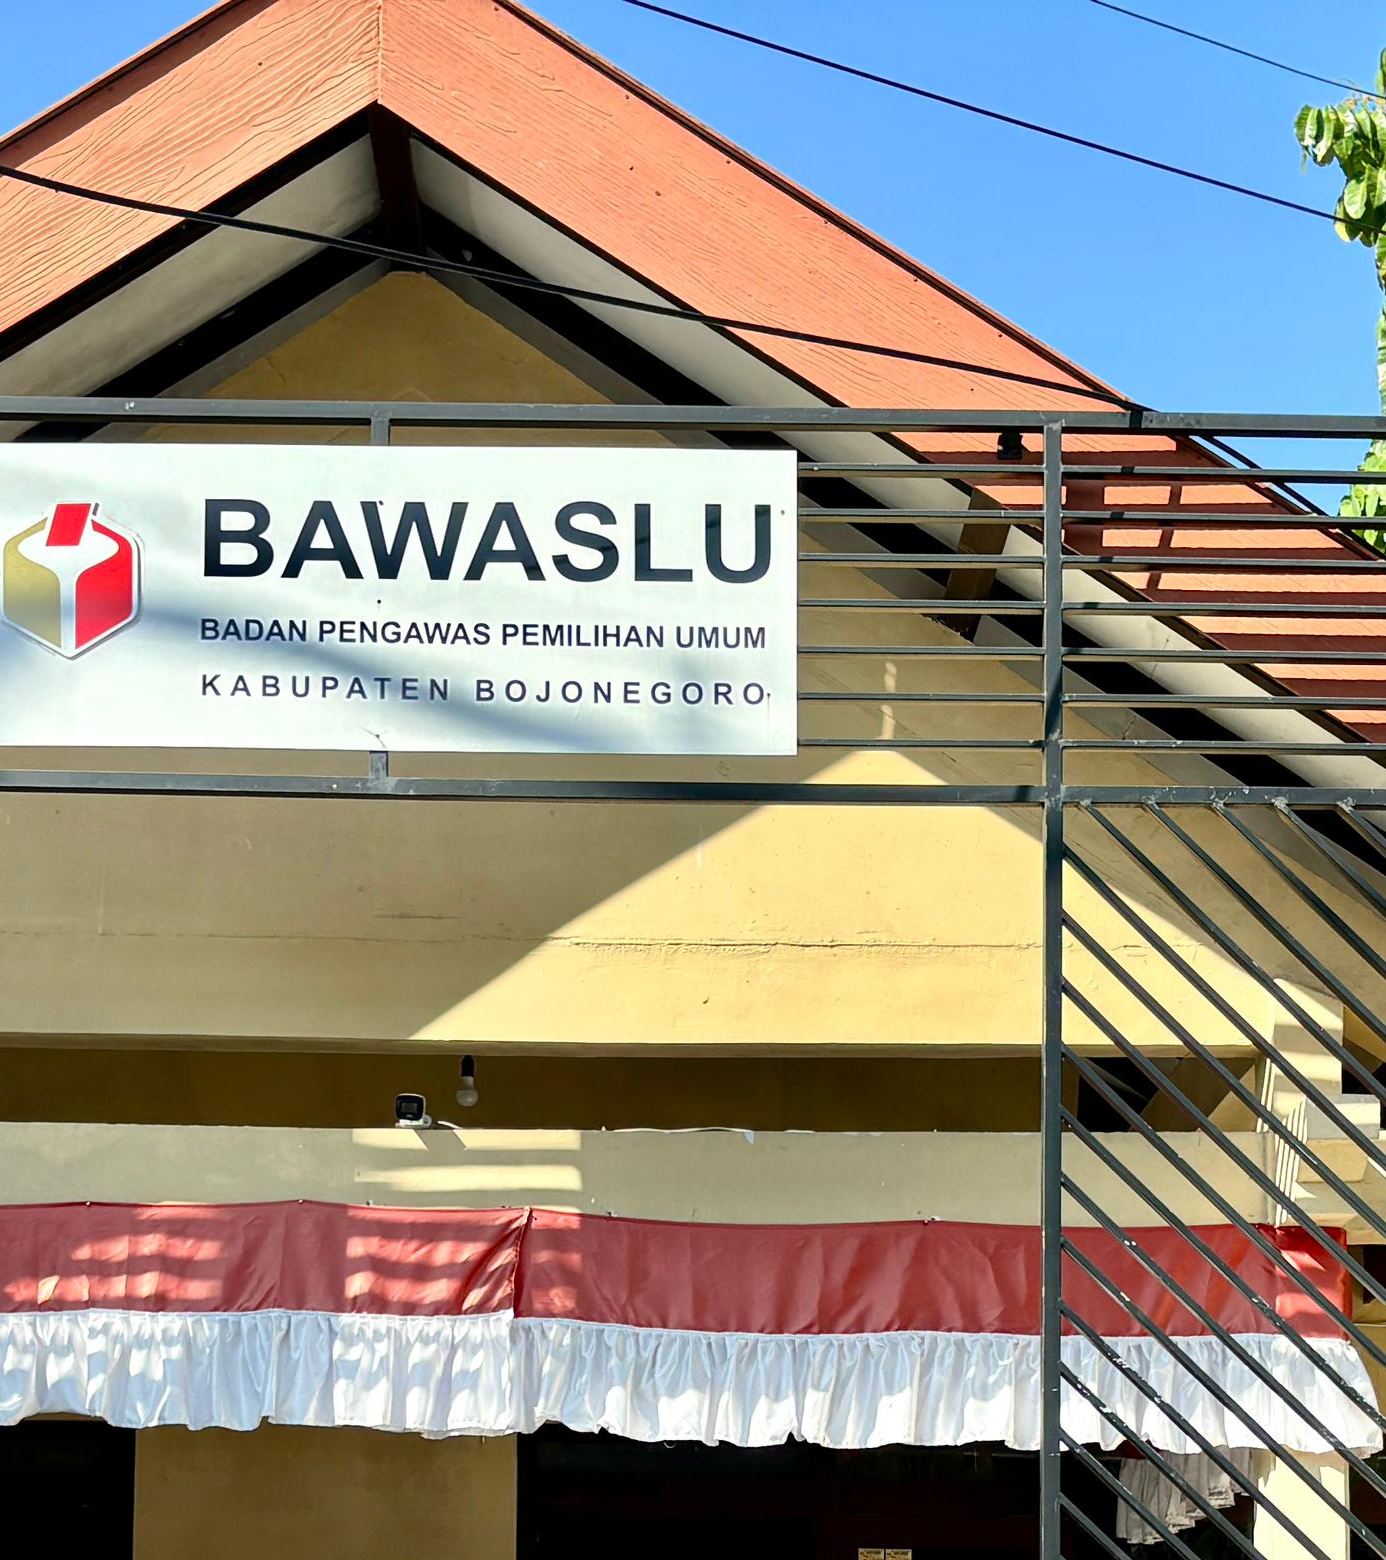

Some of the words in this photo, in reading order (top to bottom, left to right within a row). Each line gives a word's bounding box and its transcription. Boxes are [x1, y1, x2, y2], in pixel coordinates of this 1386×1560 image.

[204, 498, 771, 584] BAWASLU
[200, 618, 307, 642] BADAN
[318, 620, 491, 646] PENGAWAS
[502, 623, 664, 648] PEMILIHAN
[676, 626, 765, 649] UMUM
[201, 674, 448, 701] KABUPATEN
[475, 679, 765, 705] BOJONEGORO
